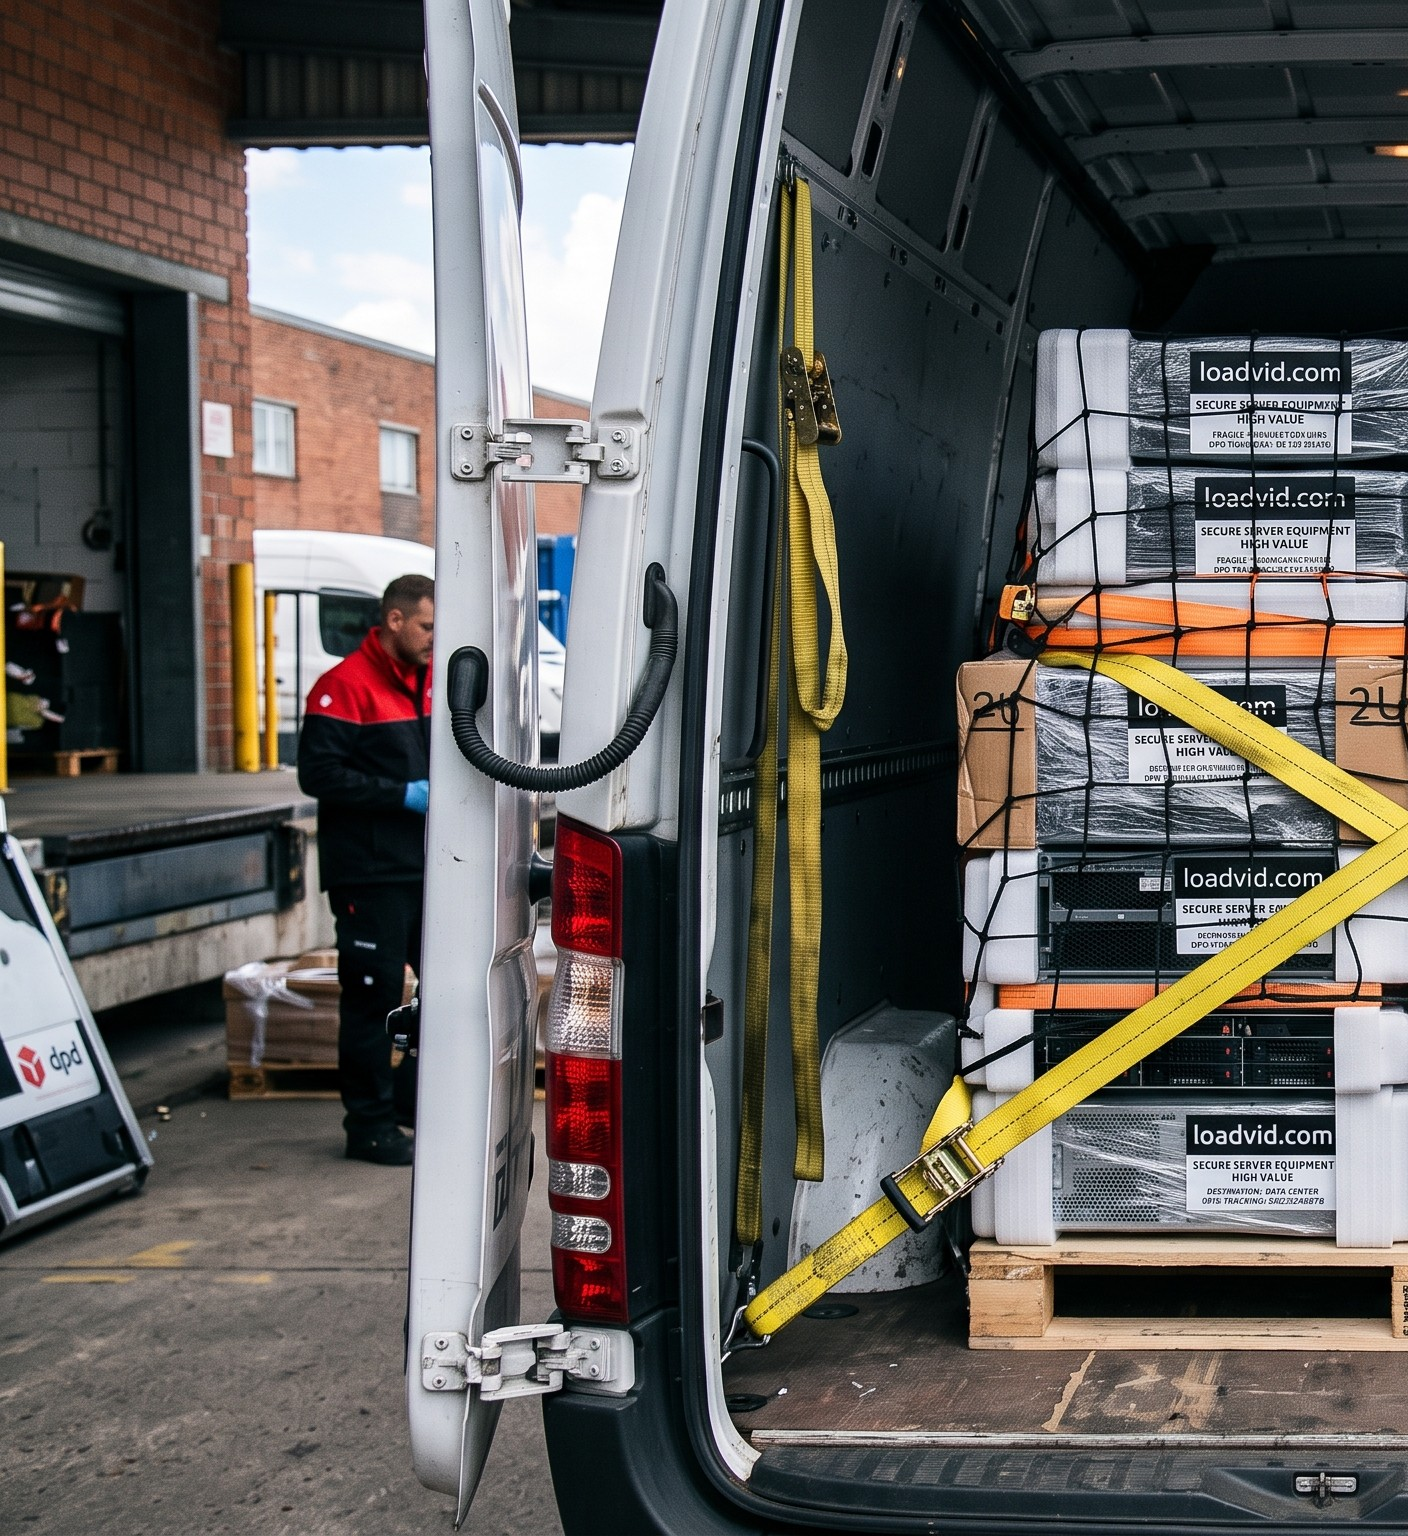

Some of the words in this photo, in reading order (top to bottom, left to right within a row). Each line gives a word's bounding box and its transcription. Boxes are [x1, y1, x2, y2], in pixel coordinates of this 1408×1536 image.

[1200, 361, 1341, 382] loadvid.com
[1195, 400, 1237, 410] SECURE
[1268, 414, 1305, 424] VALUE
[1204, 486, 1346, 508] loadvid.com
[1200, 526, 1242, 536] SECURE
[1286, 526, 1351, 536] EQUIPMENT
[1272, 539, 1309, 549] VALUE
[1134, 735, 1175, 745] SECURE
[1176, 747, 1205, 757] HIGH
[1184, 867, 1323, 888] loadvid.com
[1182, 904, 1223, 914] SECURE
[49, 1040, 82, 1075] dpd
[1194, 1123, 1333, 1145] loadvid.com
[1193, 1160, 1231, 1170] SECURE
[1233, 1160, 1273, 1170] SERVER
[1275, 1160, 1335, 1171] EQUIPMENT
[1232, 1173, 1258, 1182] HIGH
[1259, 1173, 1294, 1182] VALUE
